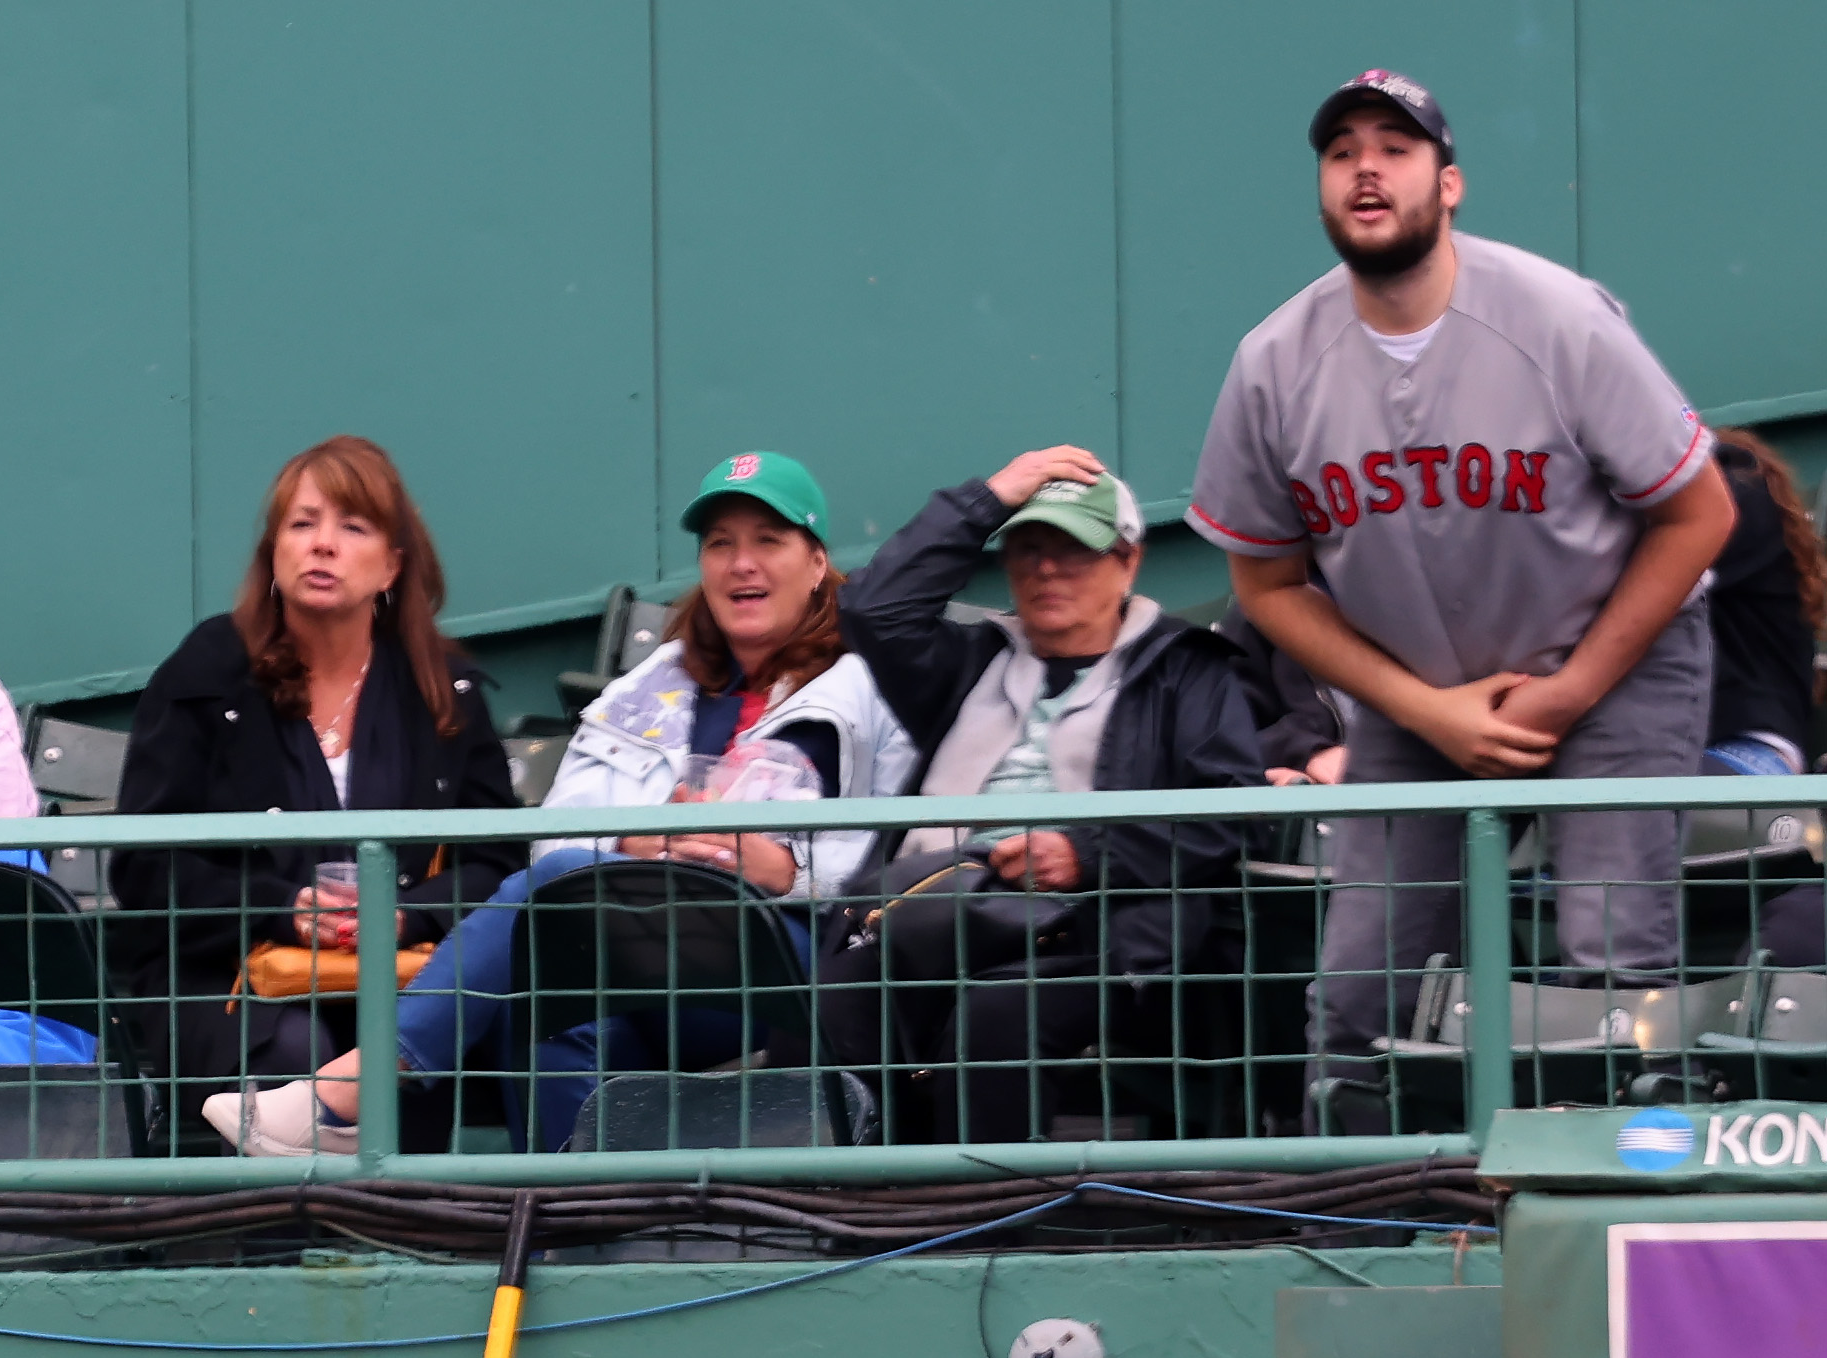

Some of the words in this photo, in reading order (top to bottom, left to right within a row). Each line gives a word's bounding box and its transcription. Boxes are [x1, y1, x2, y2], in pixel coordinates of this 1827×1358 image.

[724, 453, 761, 481] B
[1290, 442, 1550, 533] BOSTON
[1702, 1111, 1827, 1166] KON
